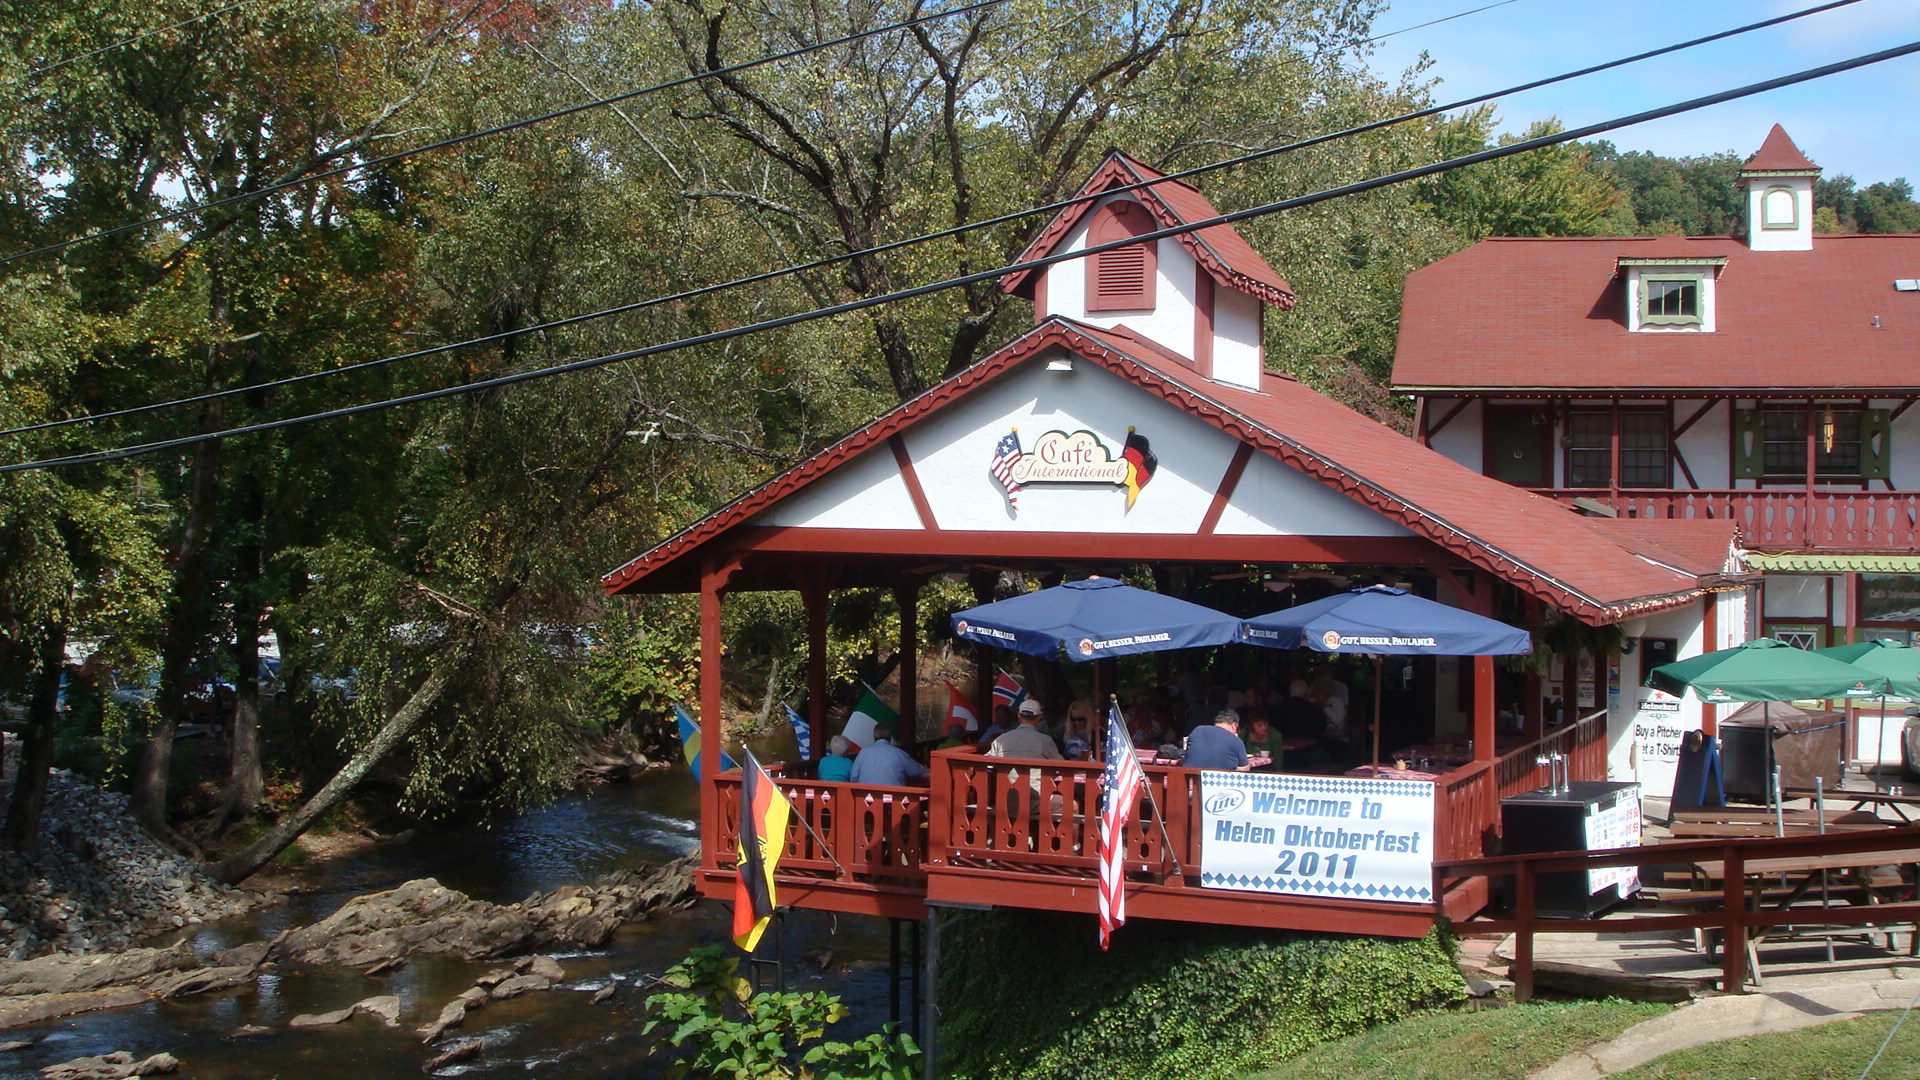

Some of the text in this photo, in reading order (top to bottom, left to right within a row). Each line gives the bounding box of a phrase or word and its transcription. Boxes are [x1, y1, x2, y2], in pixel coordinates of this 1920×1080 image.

[1040, 439, 1092, 465] Café
[1015, 459, 1124, 480] International
[1635, 724, 1682, 740] Buy a Pitcher
[1649, 746, 1655, 755] a
[1212, 796, 1239, 813] Lite
[1251, 791, 1383, 820] Welcome to
[1214, 820, 1421, 854] Helen Oktoberfest
[1274, 849, 1358, 880] 2011
